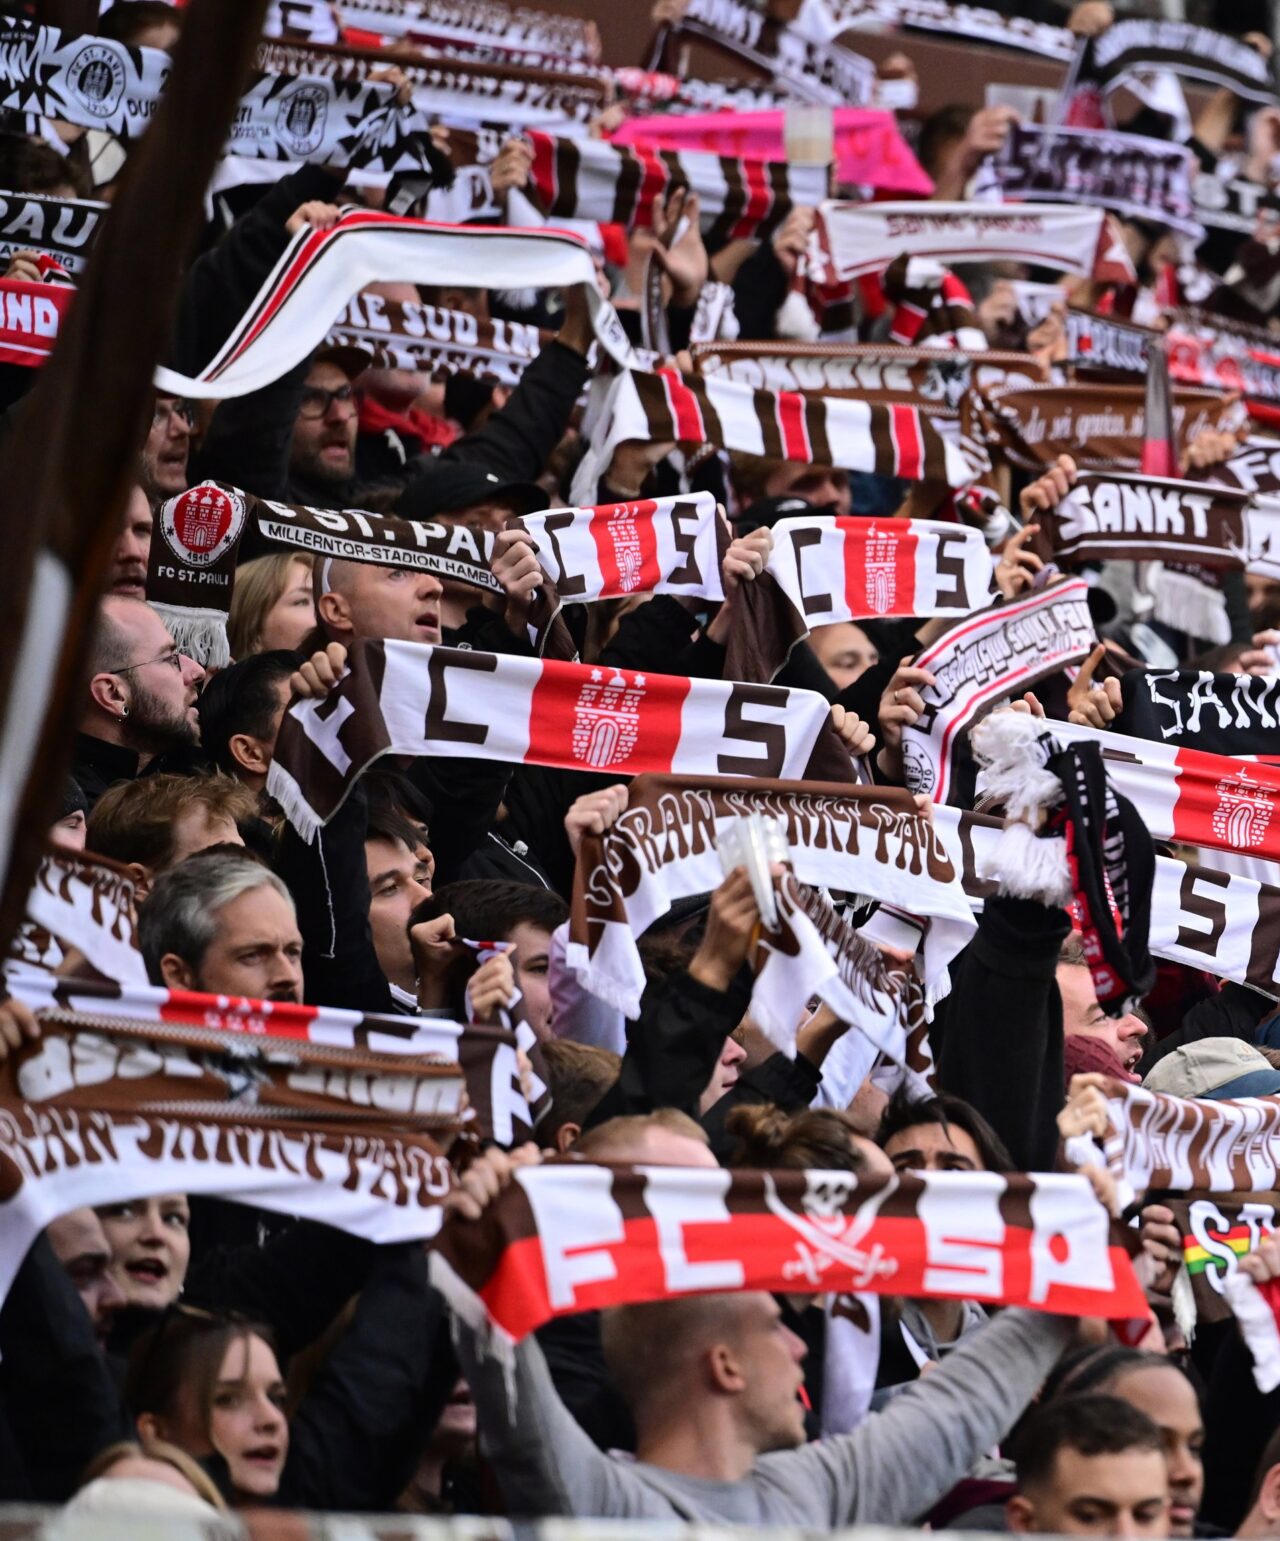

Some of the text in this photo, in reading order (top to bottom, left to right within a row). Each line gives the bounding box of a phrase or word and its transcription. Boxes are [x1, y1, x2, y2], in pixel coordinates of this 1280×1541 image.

[0, 197, 99, 248] AU
[267, 523, 441, 571] MILLERNTOR-STADION
[158, 565, 230, 587] FC ST. PAULI
